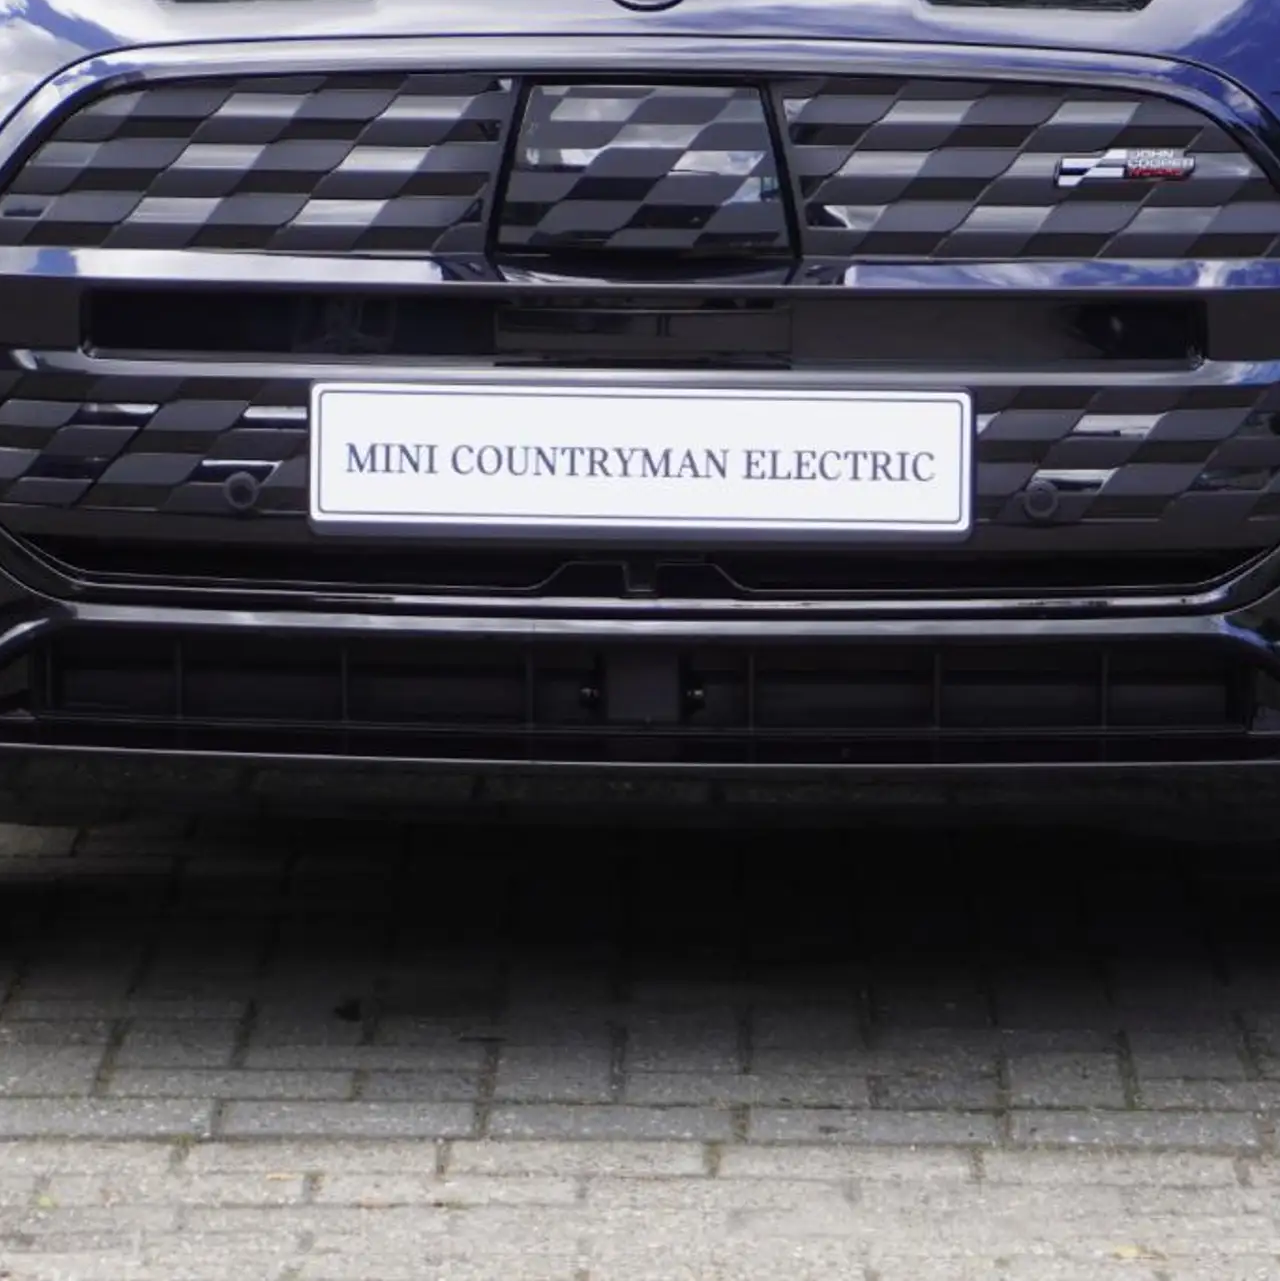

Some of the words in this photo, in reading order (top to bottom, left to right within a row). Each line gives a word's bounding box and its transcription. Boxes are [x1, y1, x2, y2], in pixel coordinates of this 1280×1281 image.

[346, 442, 438, 474] MINI
[450, 444, 729, 480] COUNTRYMAN
[742, 449, 937, 482] ELECTRIC
